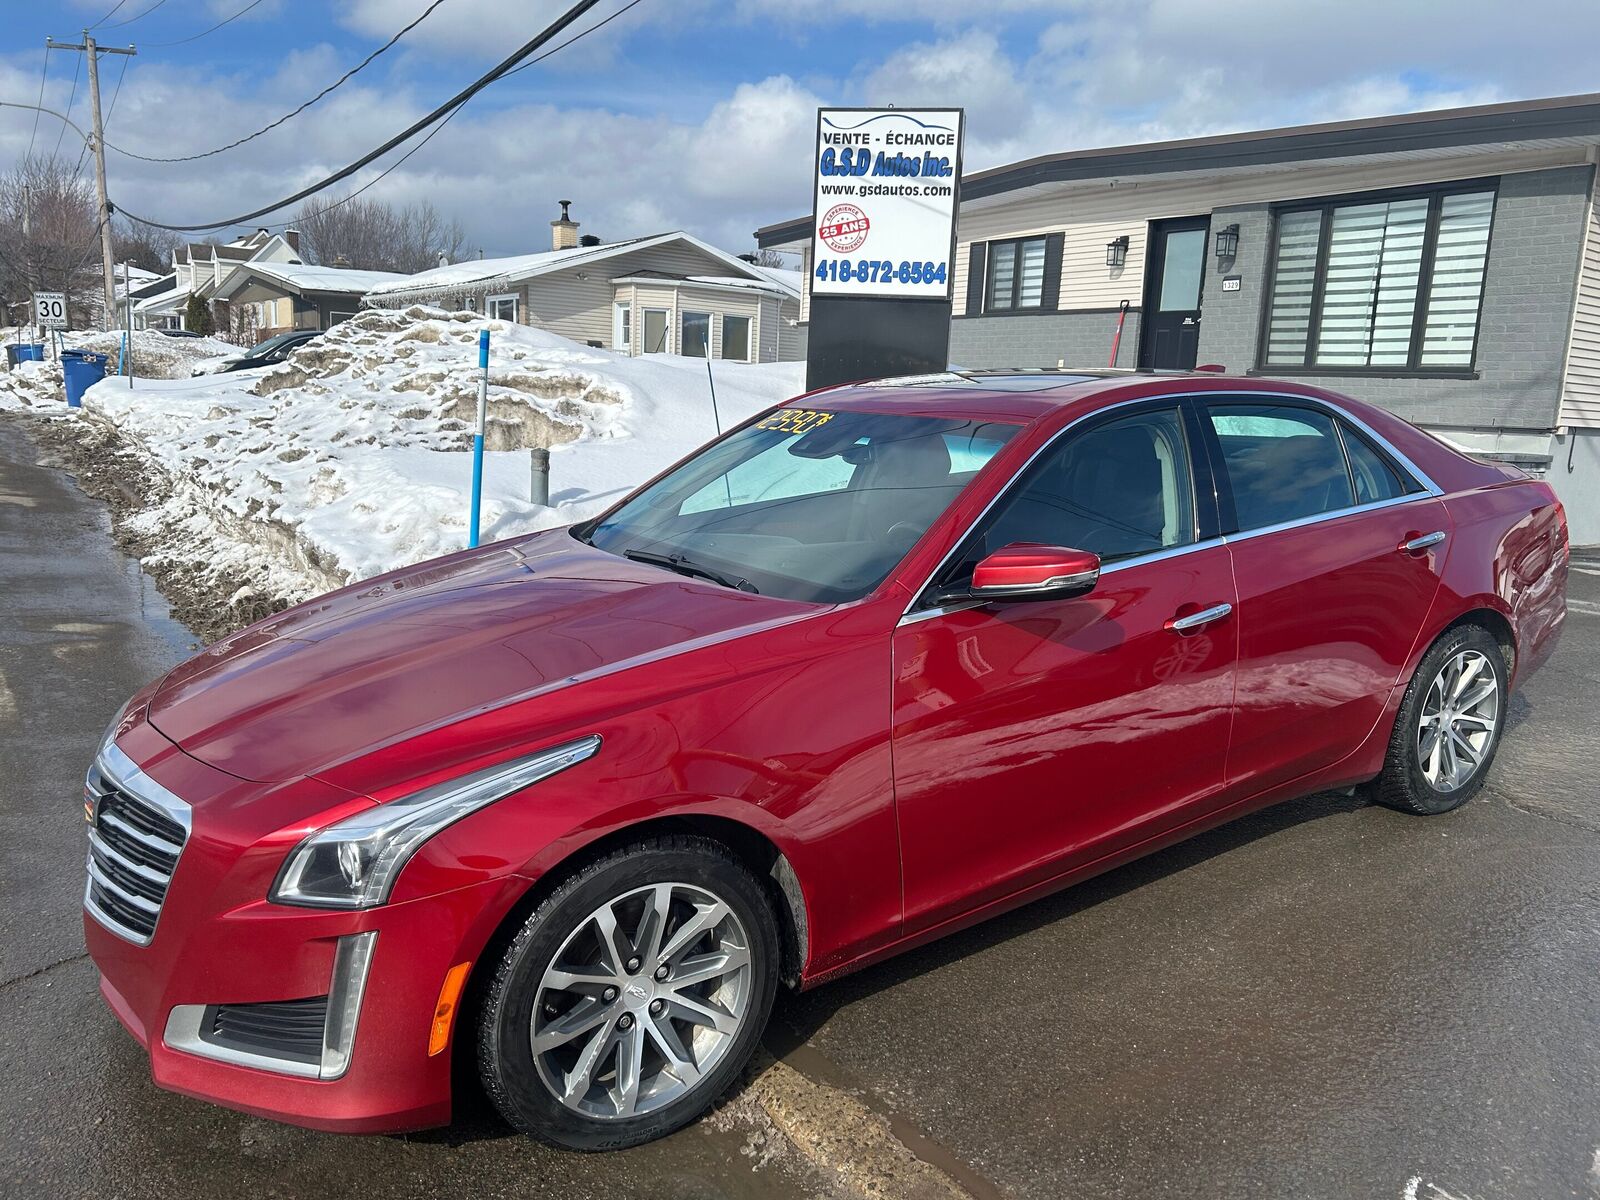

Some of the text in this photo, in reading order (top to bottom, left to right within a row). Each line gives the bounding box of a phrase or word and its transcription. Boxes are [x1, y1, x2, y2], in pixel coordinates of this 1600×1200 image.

[823, 132, 870, 145] VENTE
[885, 130, 955, 146] ÉCHANGE
[820, 147, 872, 177] G.S.D
[871, 151, 922, 177] Autos
[821, 184, 952, 197] www.gsdautos.com
[822, 220, 867, 238] 25 ANS
[816, 259, 947, 285] 418-872-6564
[39, 301, 62, 317] 30
